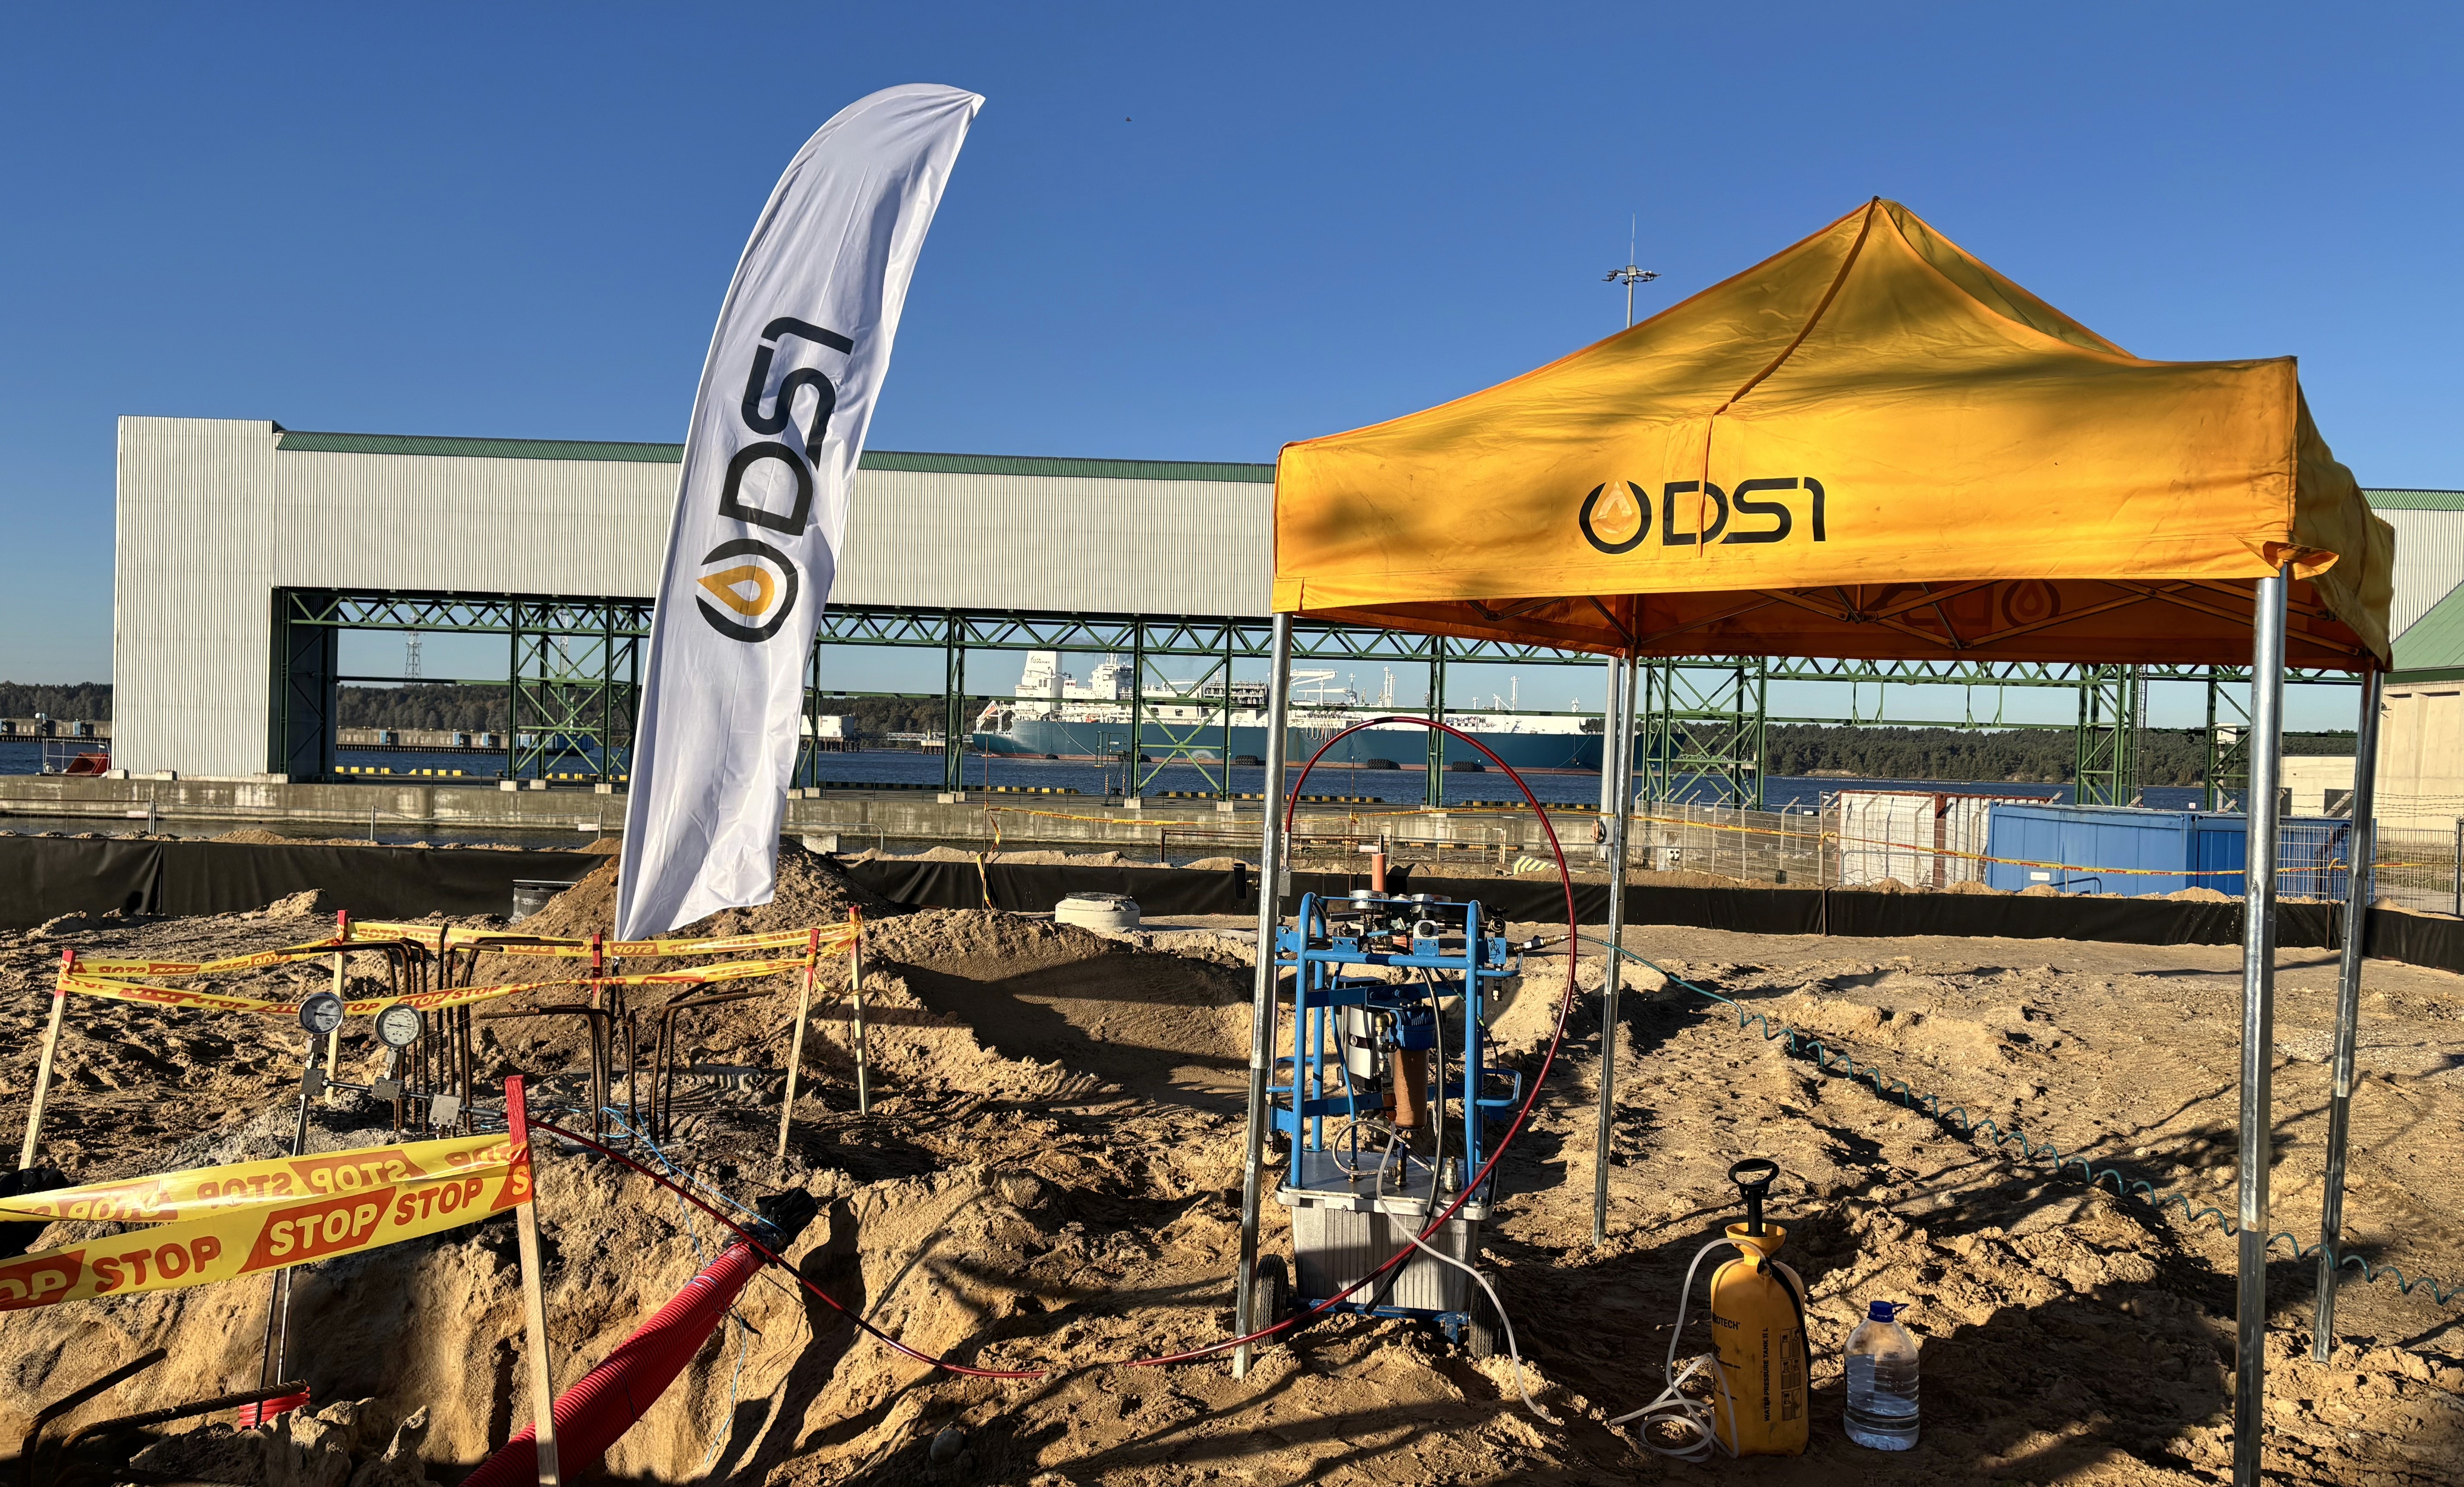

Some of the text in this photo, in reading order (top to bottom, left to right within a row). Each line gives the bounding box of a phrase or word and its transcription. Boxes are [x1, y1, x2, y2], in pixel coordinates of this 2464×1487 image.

[343, 1002, 380, 1012] TOP
[452, 985, 503, 999] STOP
[92, 1236, 221, 1293] STOP
[270, 1203, 378, 1256] STOP
[394, 1177, 483, 1226] STOP
